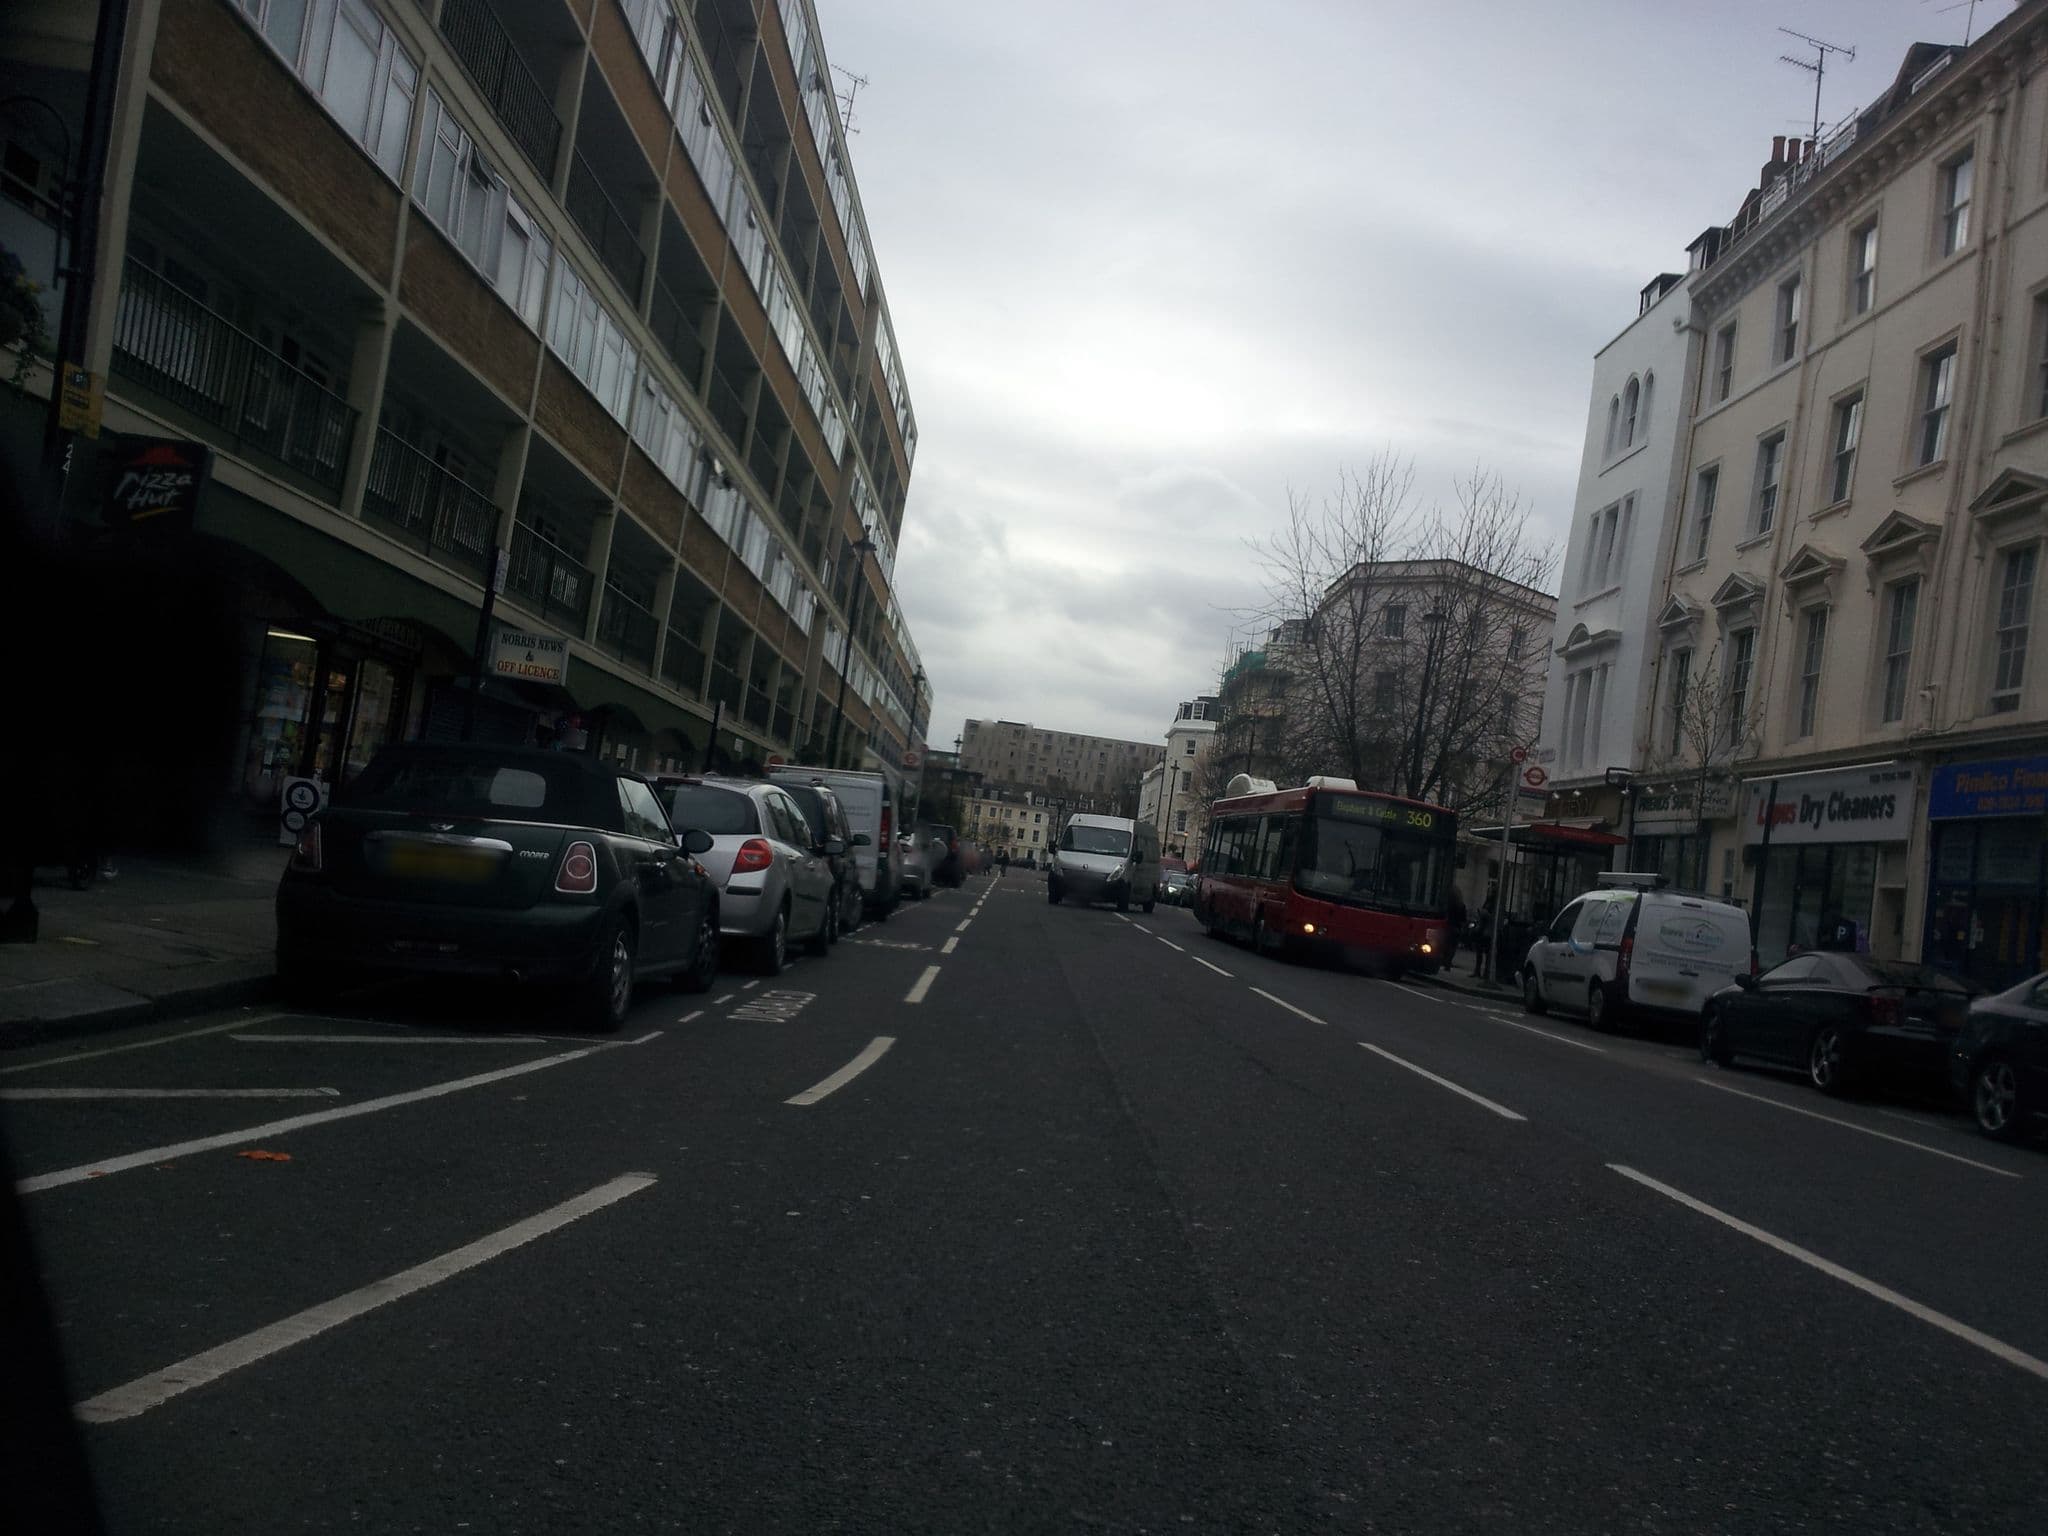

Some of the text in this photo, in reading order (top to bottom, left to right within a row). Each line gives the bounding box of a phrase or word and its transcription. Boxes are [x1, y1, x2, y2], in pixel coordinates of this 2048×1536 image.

[114, 467, 194, 500] Pizza
[128, 489, 185, 511] Hut
[502, 633, 564, 652] NORRIS NEWS
[526, 651, 534, 661] &
[497, 660, 560, 679] OFF LICENCE
[1407, 810, 1432, 827] 360
[1756, 798, 1797, 831] Lpus
[1799, 794, 1825, 829] Dry
[1827, 791, 1896, 821] Cleaners
